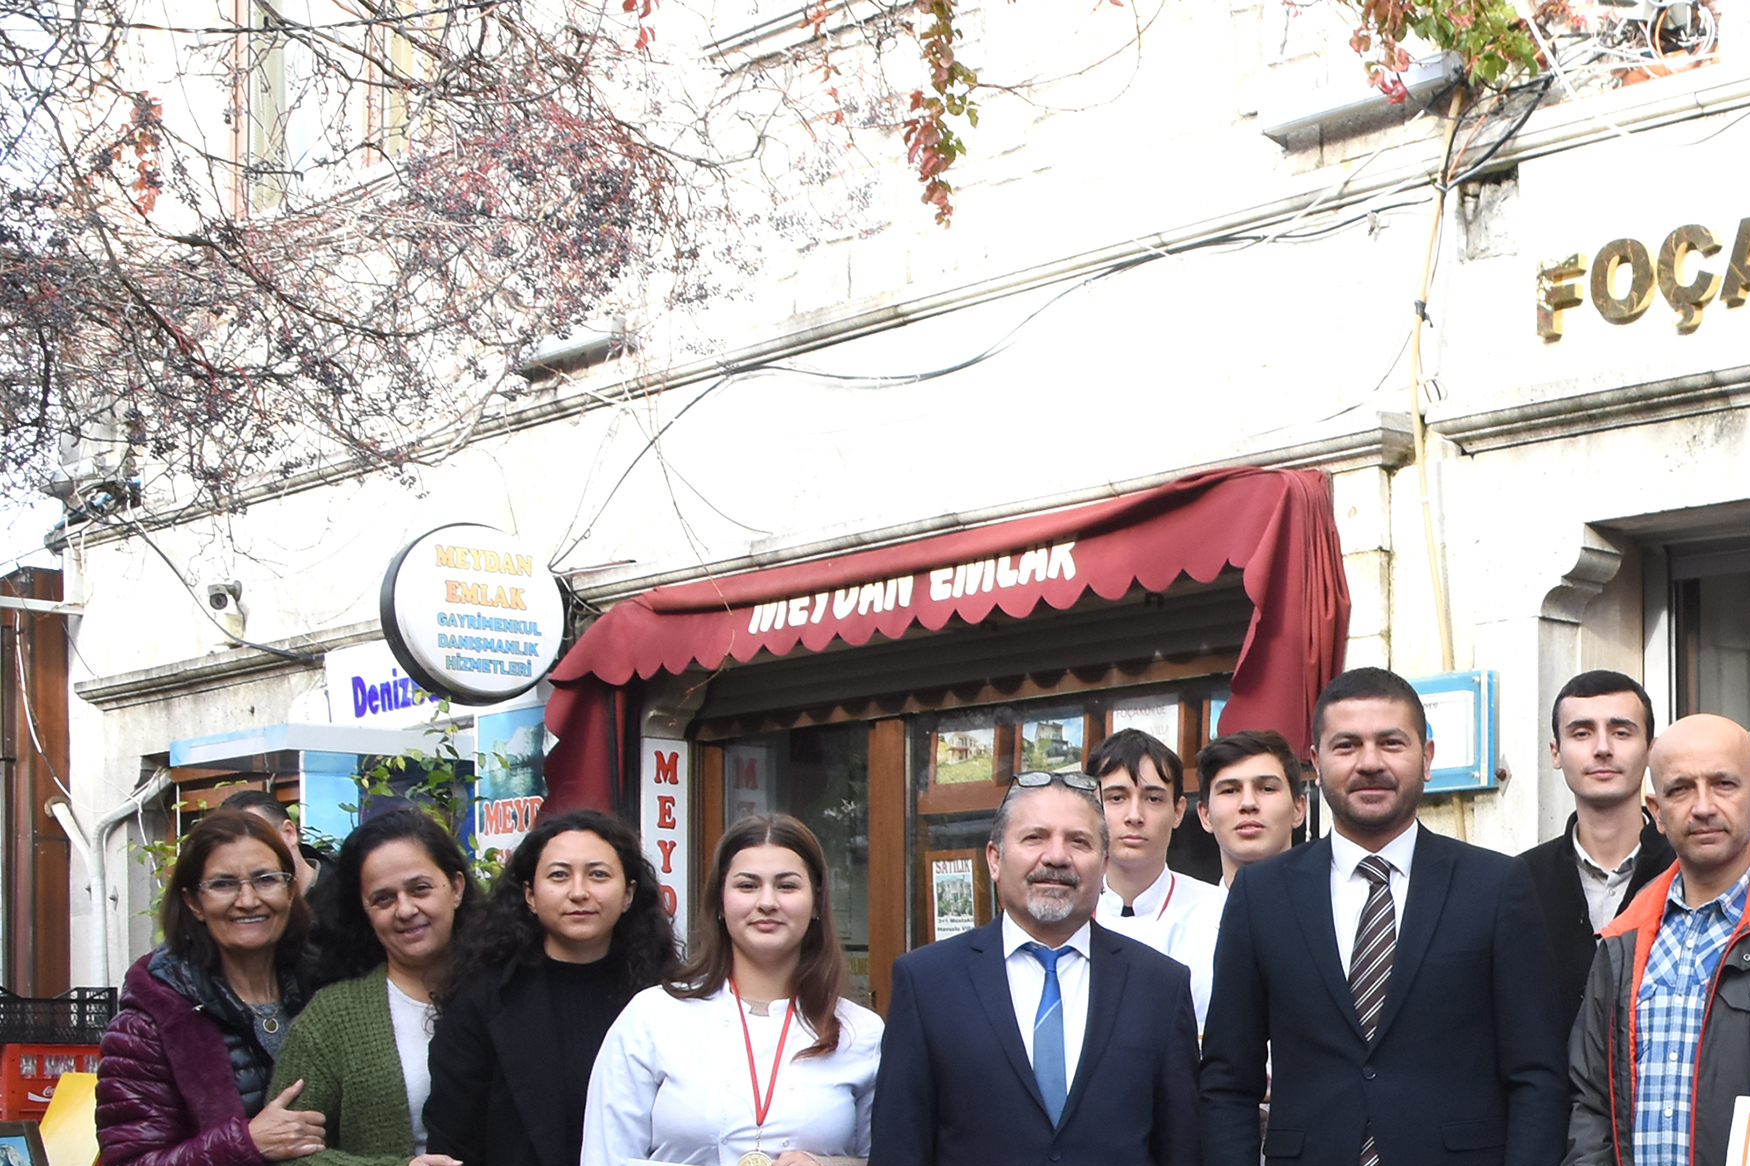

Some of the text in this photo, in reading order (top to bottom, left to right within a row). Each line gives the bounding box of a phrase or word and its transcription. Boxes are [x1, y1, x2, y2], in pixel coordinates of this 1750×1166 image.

[435, 544, 532, 577] MEYDAN
[930, 541, 1076, 602] EMLAK
[445, 580, 527, 610] EMLAK
[437, 612, 542, 636] GAYRİMENKUL
[438, 633, 539, 657] DANIŞMANLIK
[445, 652, 532, 677] HİZMETLERİ
